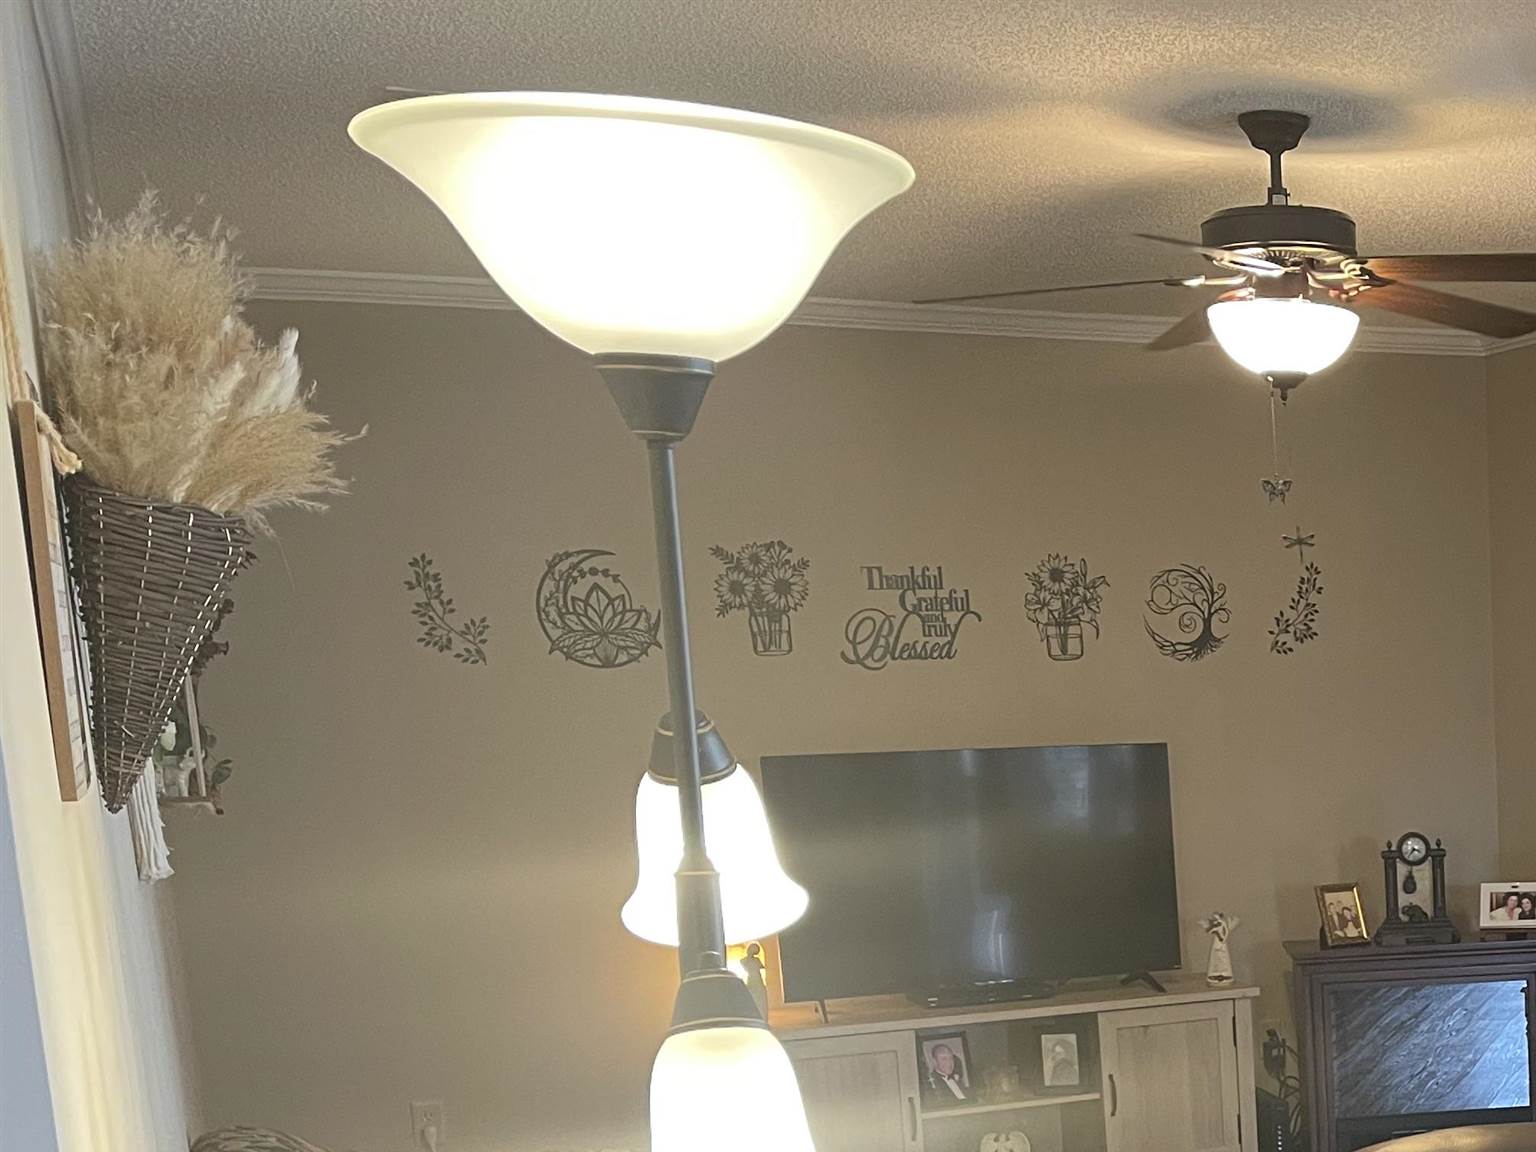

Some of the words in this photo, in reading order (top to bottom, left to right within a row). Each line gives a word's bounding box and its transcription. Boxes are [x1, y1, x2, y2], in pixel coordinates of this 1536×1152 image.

[860, 566, 944, 590] Thankful
[899, 588, 971, 613] Grateful
[922, 611, 946, 624] and
[922, 618, 958, 637] truly
[840, 608, 982, 671] Blessed
